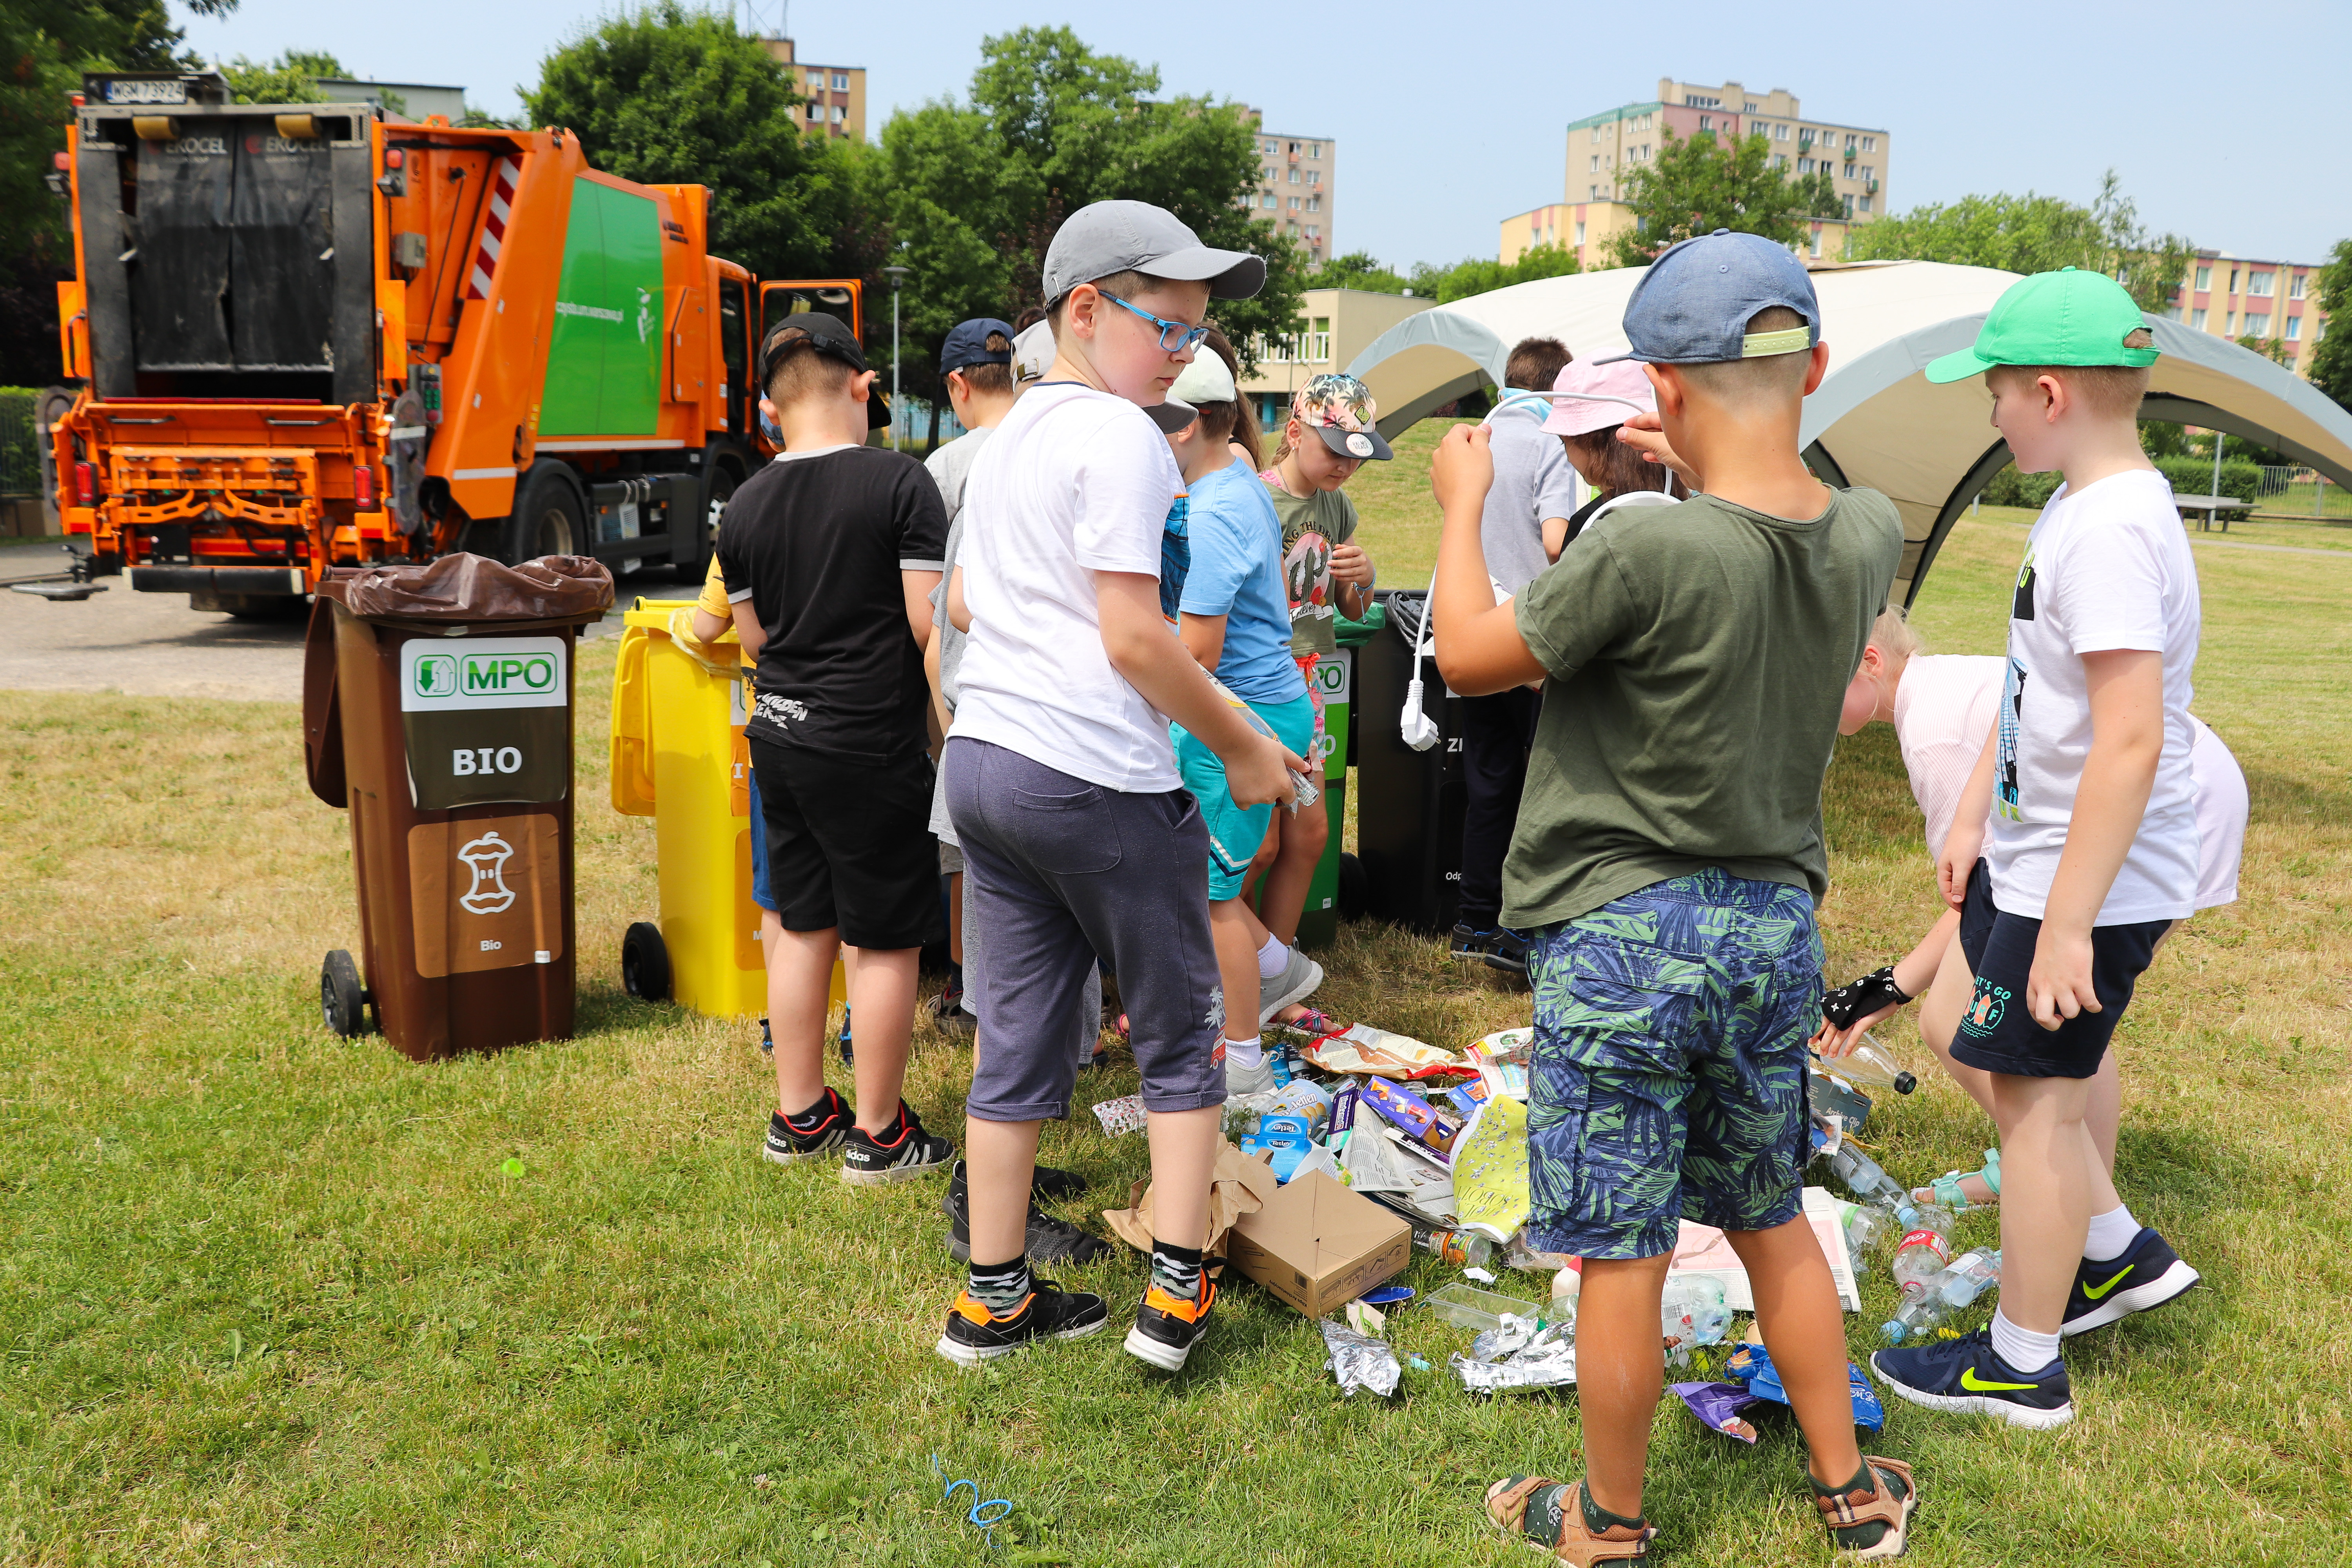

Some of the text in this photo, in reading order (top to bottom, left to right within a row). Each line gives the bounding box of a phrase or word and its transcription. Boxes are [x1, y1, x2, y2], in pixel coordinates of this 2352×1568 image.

[143, 82, 183, 98] 73924
[468, 659, 552, 689] MPO
[453, 746, 523, 776] BIO
[480, 939, 503, 951] Bio
[1993, 986, 2011, 1000] GO
[1969, 999, 1999, 1021] URF
[1270, 1123, 1296, 1132] Tetley
[1849, 1116, 1860, 1127] Clip
[1296, 1298, 1307, 1308] Klips
